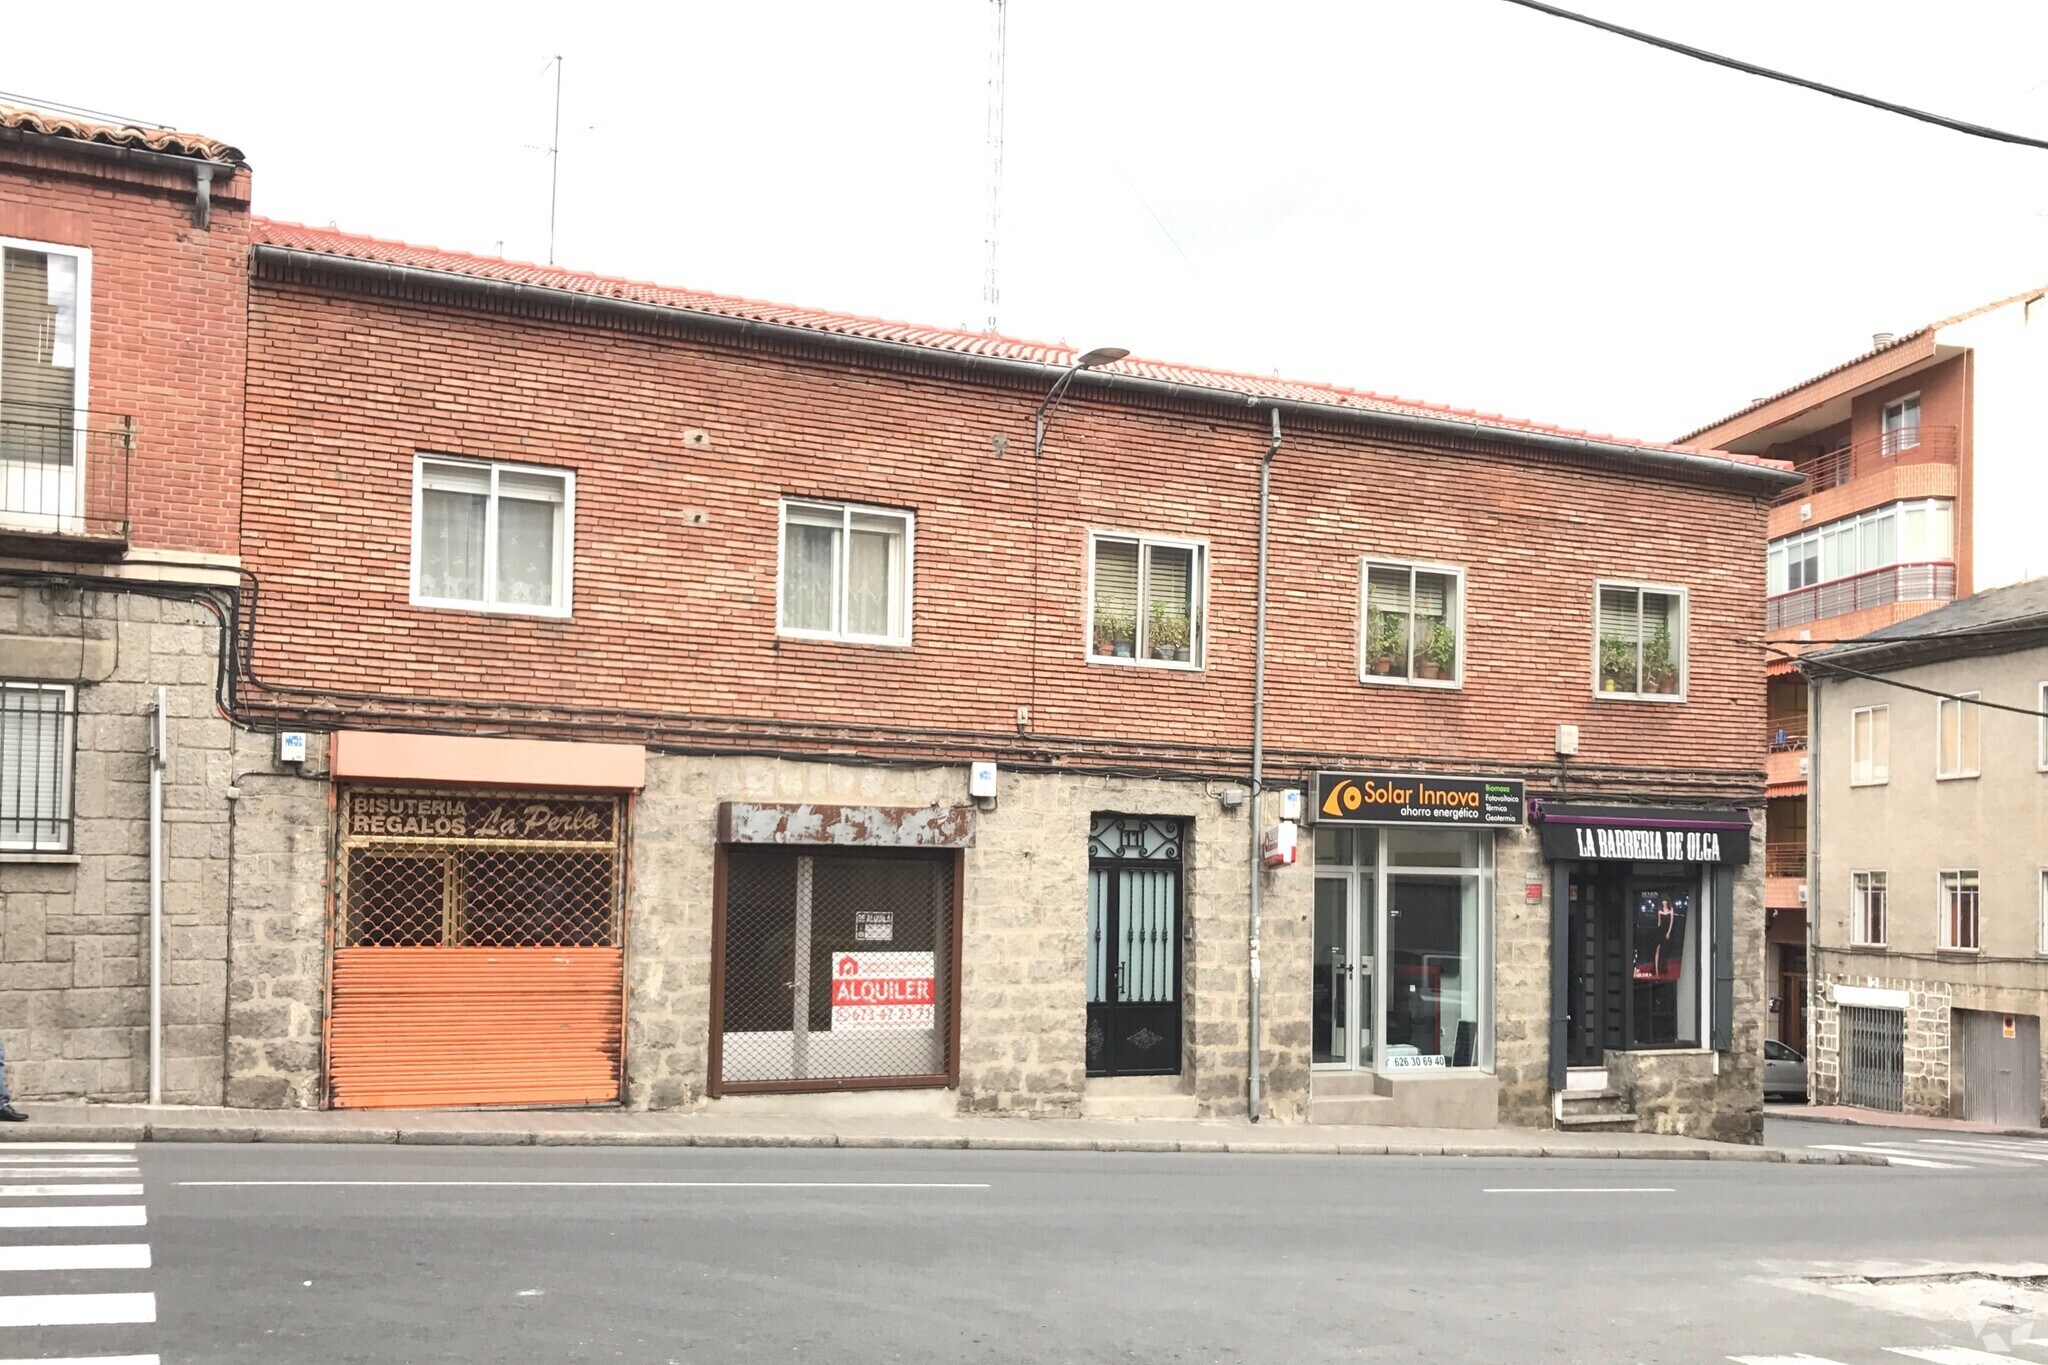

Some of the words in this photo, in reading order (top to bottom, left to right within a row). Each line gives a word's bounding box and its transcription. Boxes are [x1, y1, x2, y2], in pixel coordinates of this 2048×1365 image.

[1365, 781, 1413, 803] Solar
[1419, 783, 1480, 807] Innova
[1485, 784, 1510, 792] Biomasa
[354, 797, 467, 816] BISUTERIA
[1485, 794, 1520, 803] Fotovoltaica
[1400, 804, 1432, 817] ahorro
[1433, 806, 1479, 820] energético
[1485, 803, 1508, 812] Térmica
[354, 815, 466, 836] REGALOS
[474, 806, 519, 836] La
[524, 805, 601, 835] Perla
[1485, 813, 1516, 822] Geotermia
[1576, 828, 1597, 857] LA
[1598, 829, 1664, 861] BARBERIA
[1666, 832, 1684, 861] DE
[1687, 832, 1721, 861] OLGA
[837, 981, 930, 1003] ALQUILER
[1394, 1057, 1409, 1067] 626
[1411, 1056, 1421, 1066] 30
[1422, 1056, 1433, 1066] 69
[1434, 1056, 1445, 1066] 40
